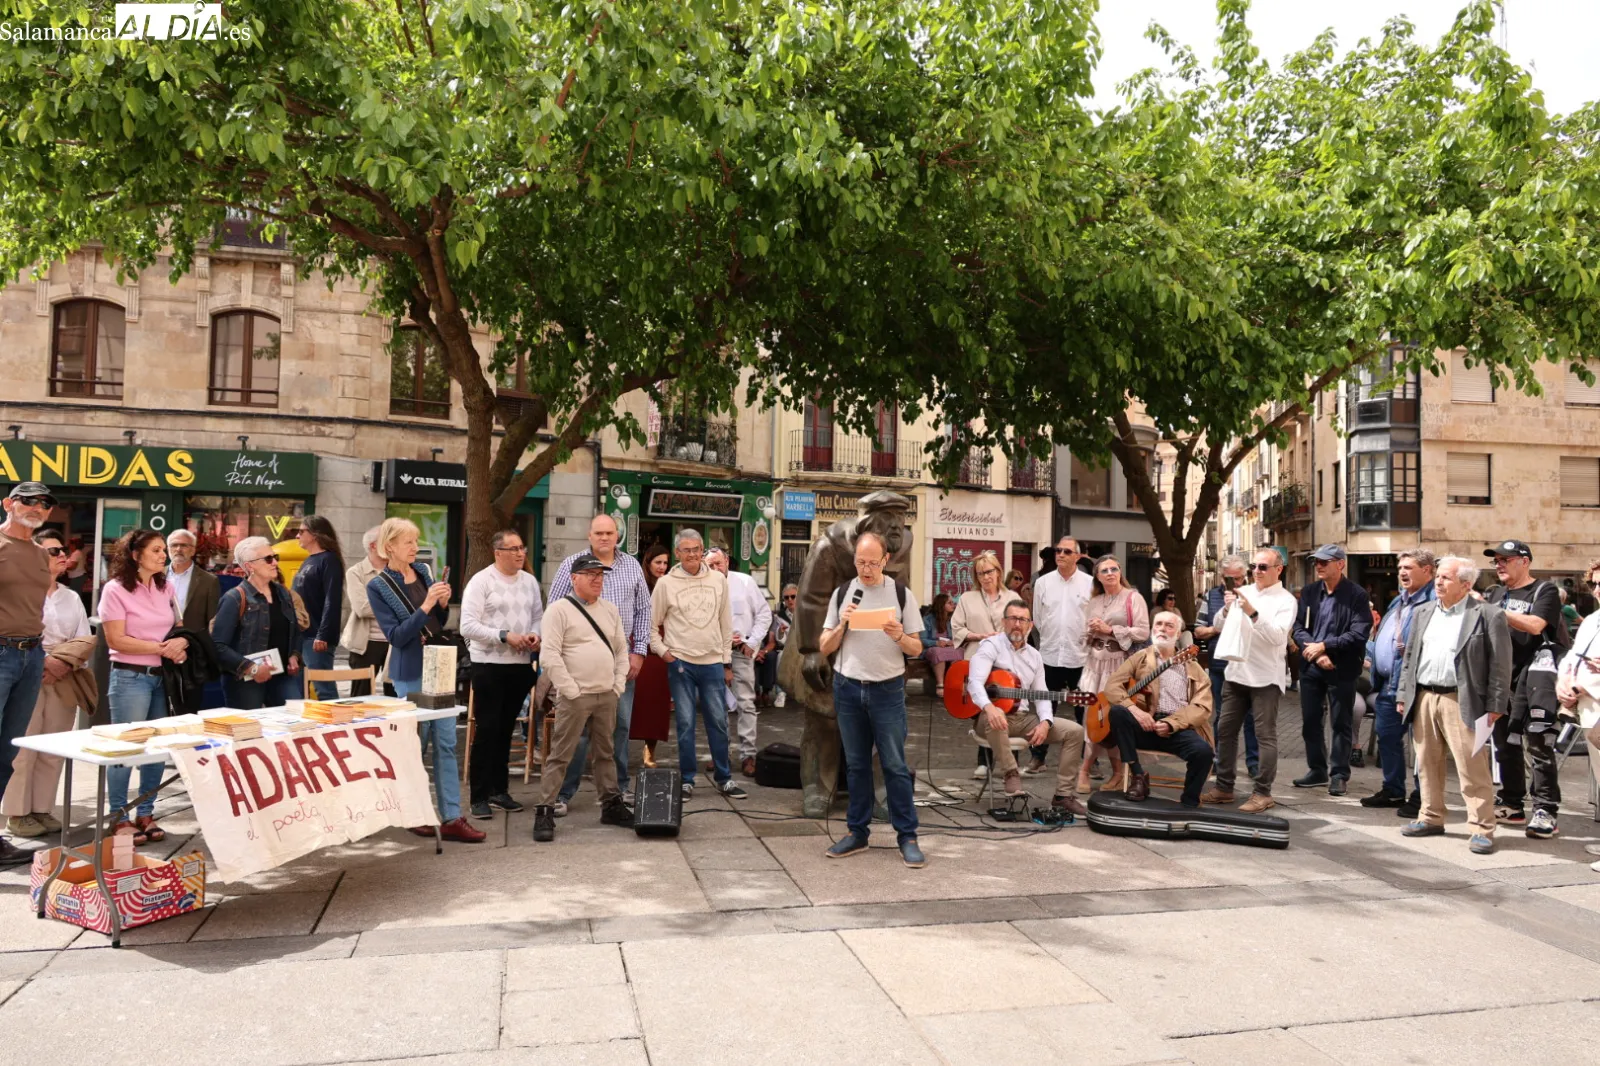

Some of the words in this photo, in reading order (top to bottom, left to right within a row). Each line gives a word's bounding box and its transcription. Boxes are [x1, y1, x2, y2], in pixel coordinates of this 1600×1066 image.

[231, 452, 266, 471] Home
[268, 453, 280, 473] of
[225, 471, 252, 486] Pata
[255, 472, 285, 490] Negra
[413, 477, 435, 486] CAJA
[437, 479, 467, 488] RURAL
[834, 494, 858, 510] CARME
[940, 508, 1003, 524] Electricidad
[947, 527, 995, 536] LIVIANOS
[247, 817, 260, 841] el
[272, 800, 321, 842] poeta
